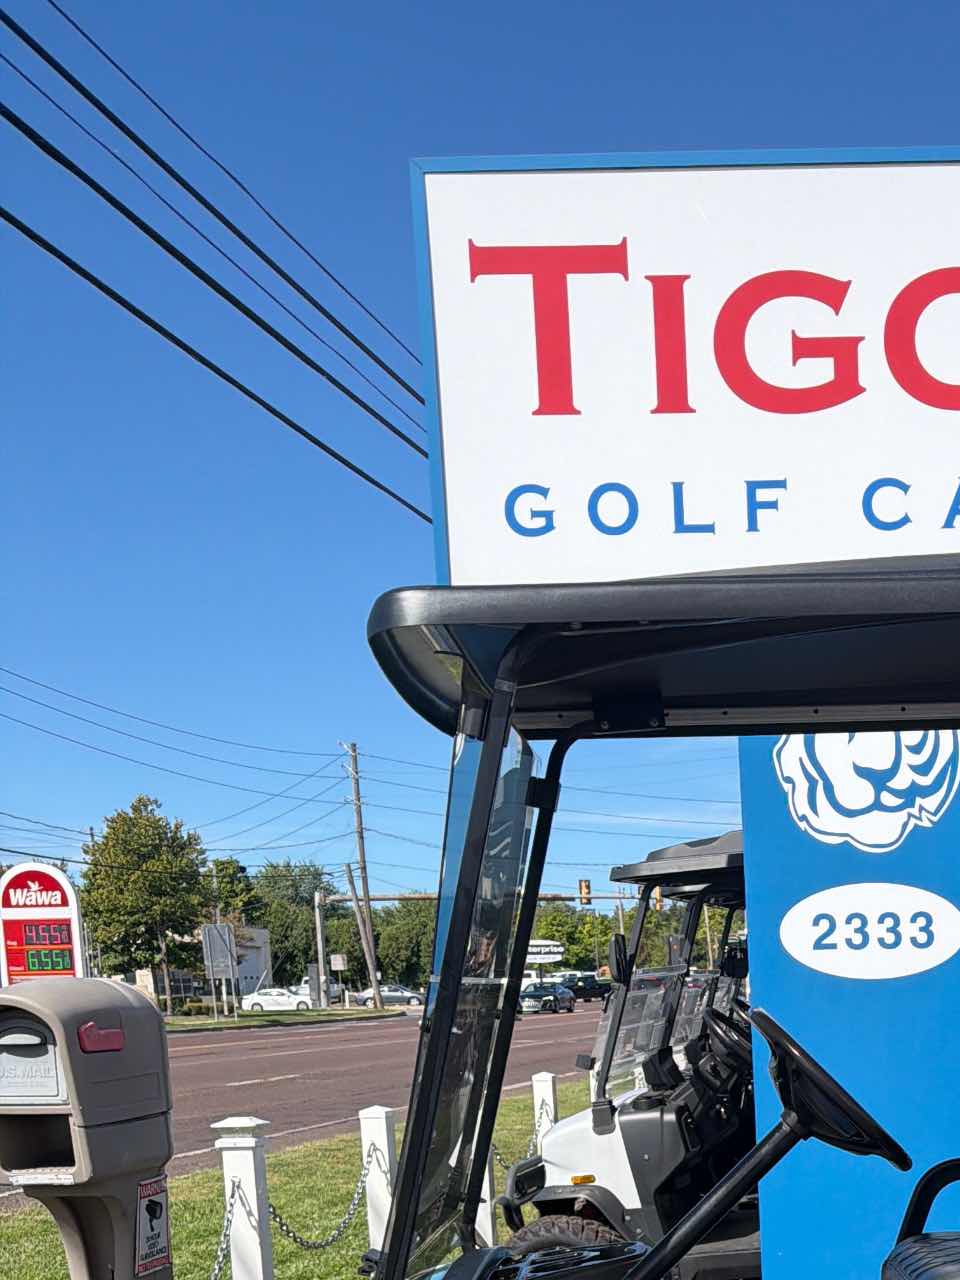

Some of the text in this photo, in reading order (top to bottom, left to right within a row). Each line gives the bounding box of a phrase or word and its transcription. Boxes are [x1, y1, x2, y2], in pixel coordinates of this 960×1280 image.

[504, 480, 787, 537] GOLF
[9, 888, 62, 906] Wawa
[812, 911, 935, 951] 2333
